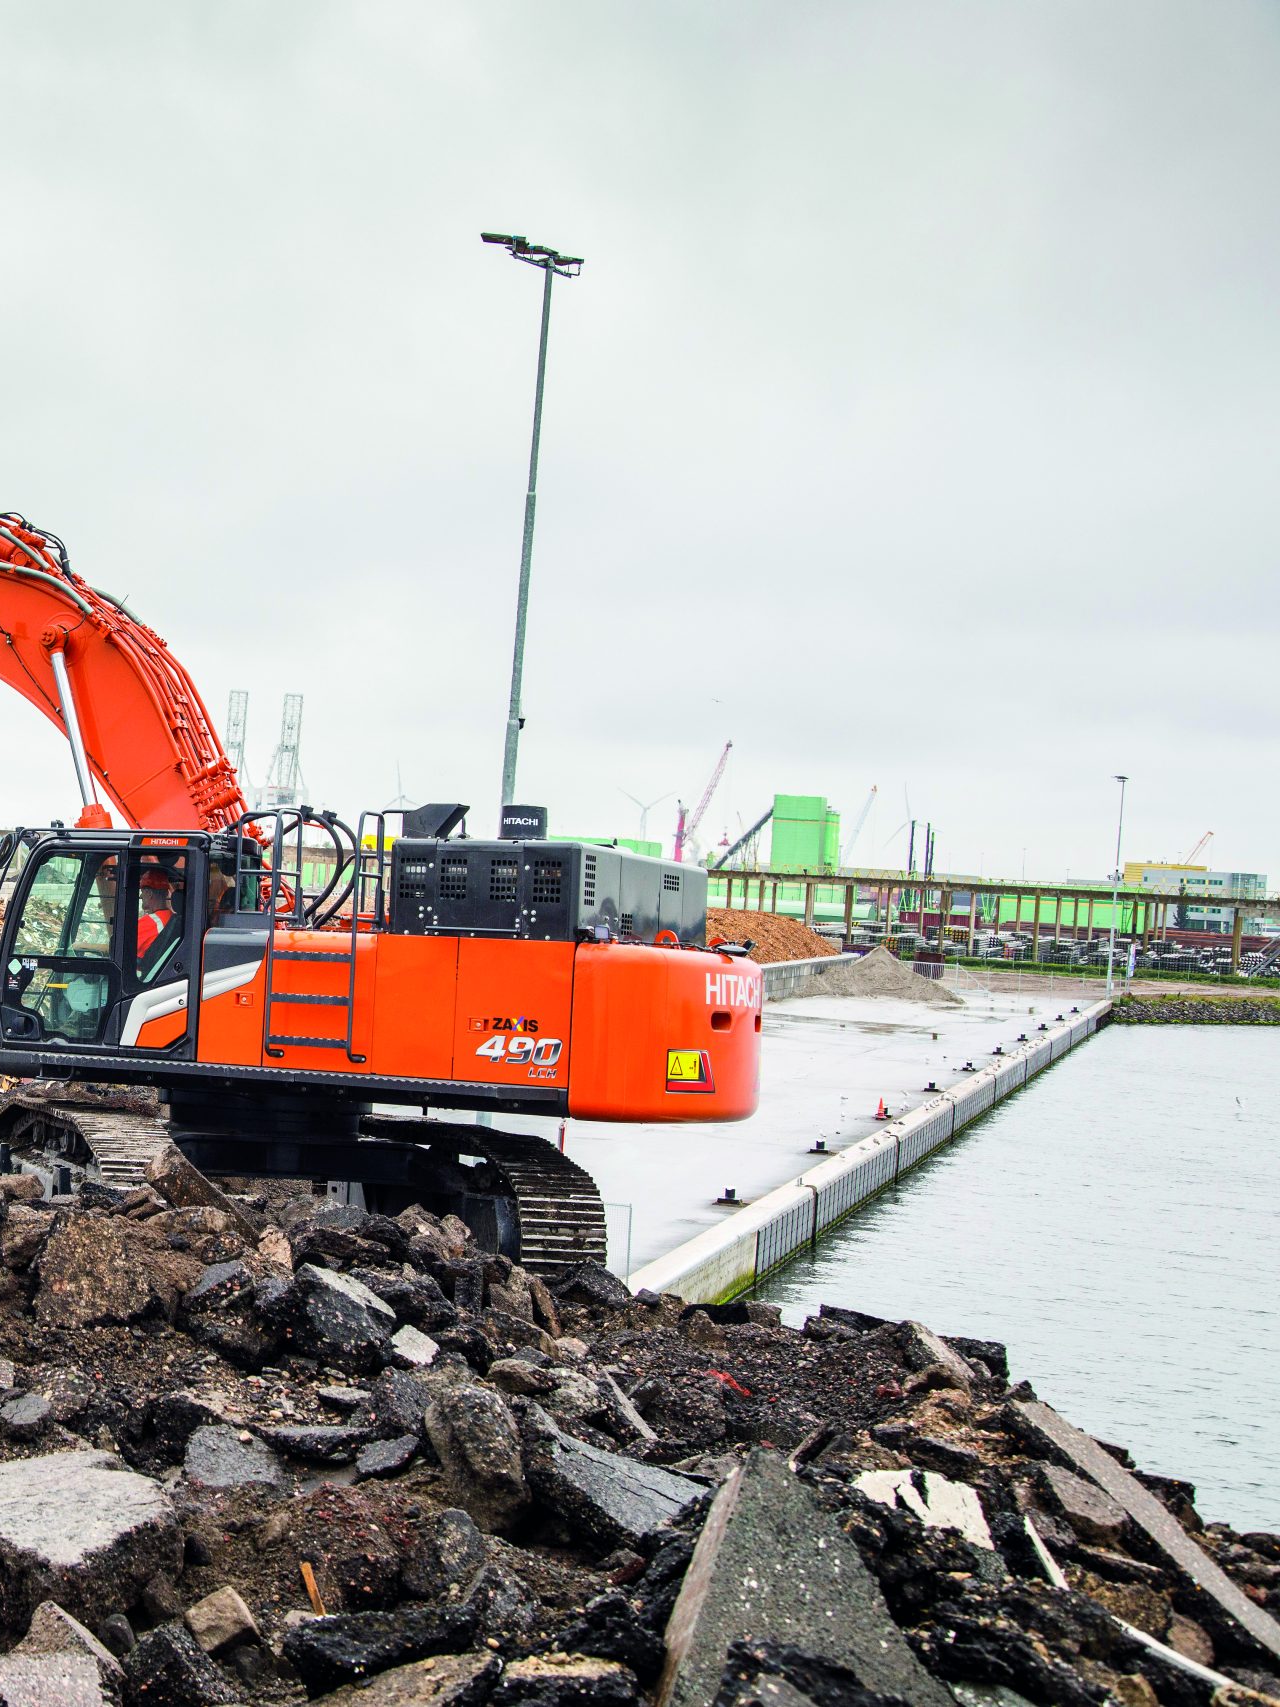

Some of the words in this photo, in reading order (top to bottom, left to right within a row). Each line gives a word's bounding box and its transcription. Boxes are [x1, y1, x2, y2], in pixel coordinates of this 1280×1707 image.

[503, 817, 539, 826] HITACHI
[705, 972, 761, 1008] HITACH
[492, 1016, 538, 1032] ZAXIS
[475, 1034, 562, 1066] 490
[527, 1067, 557, 1079] LCH
